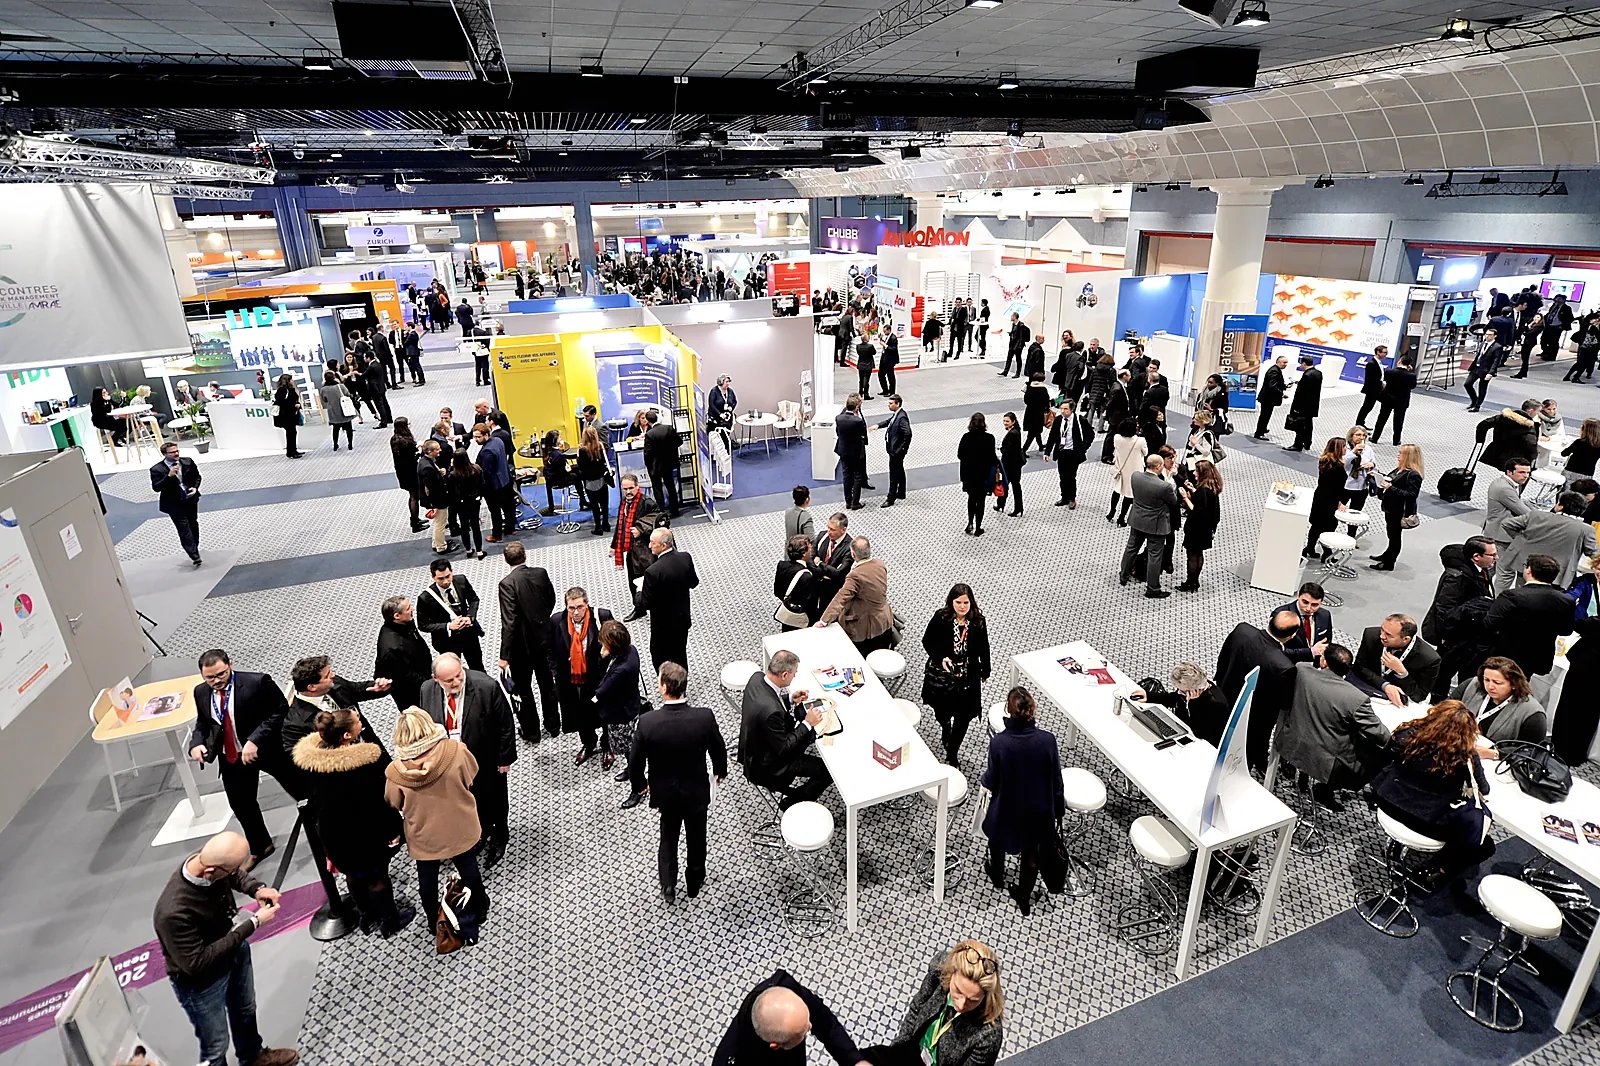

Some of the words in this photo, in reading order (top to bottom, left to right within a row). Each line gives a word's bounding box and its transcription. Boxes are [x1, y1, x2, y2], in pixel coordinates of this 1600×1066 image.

[827, 227, 859, 239] CHUBB
[8, 293, 60, 301] MANAGEMENT
[894, 294, 906, 307] AON
[225, 303, 289, 330] HDI
[245, 408, 270, 418] HDI
[114, 951, 150, 972] Deau
[118, 962, 148, 988] 20
[0, 994, 63, 1026] communic
